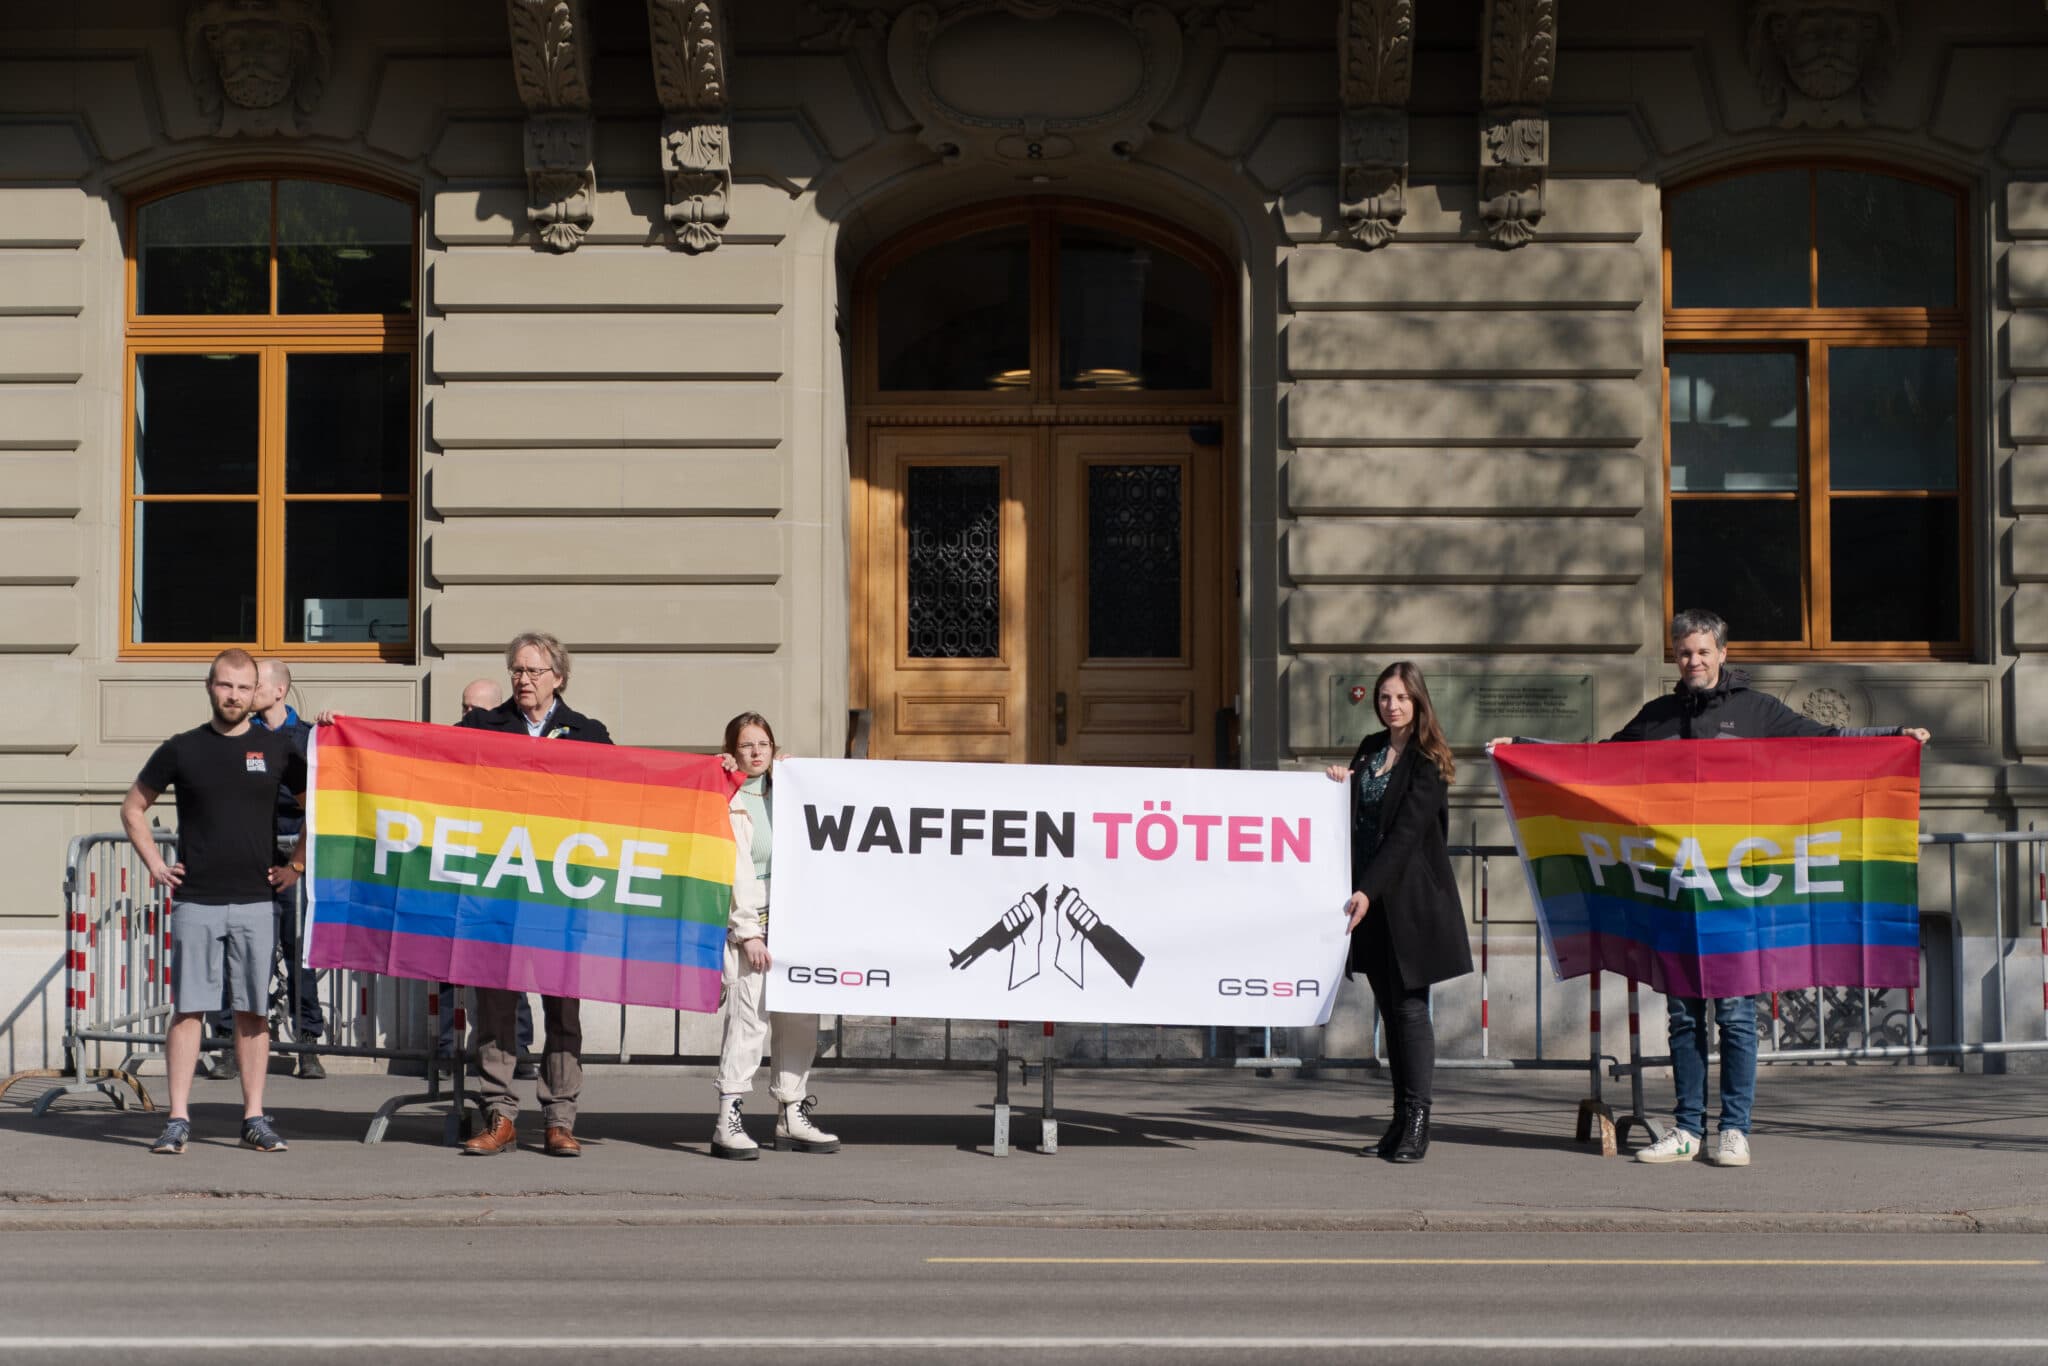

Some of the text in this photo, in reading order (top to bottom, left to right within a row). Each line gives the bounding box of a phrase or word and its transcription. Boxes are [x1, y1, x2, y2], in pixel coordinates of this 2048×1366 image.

[1027, 143, 1043, 160] 8
[803, 800, 1311, 863] WAFFEN TÖTEN
[373, 808, 669, 908] PEACE
[1580, 831, 1844, 902] PEACE
[788, 966, 890, 987] GSoA
[1218, 978, 1319, 997] GSsA
